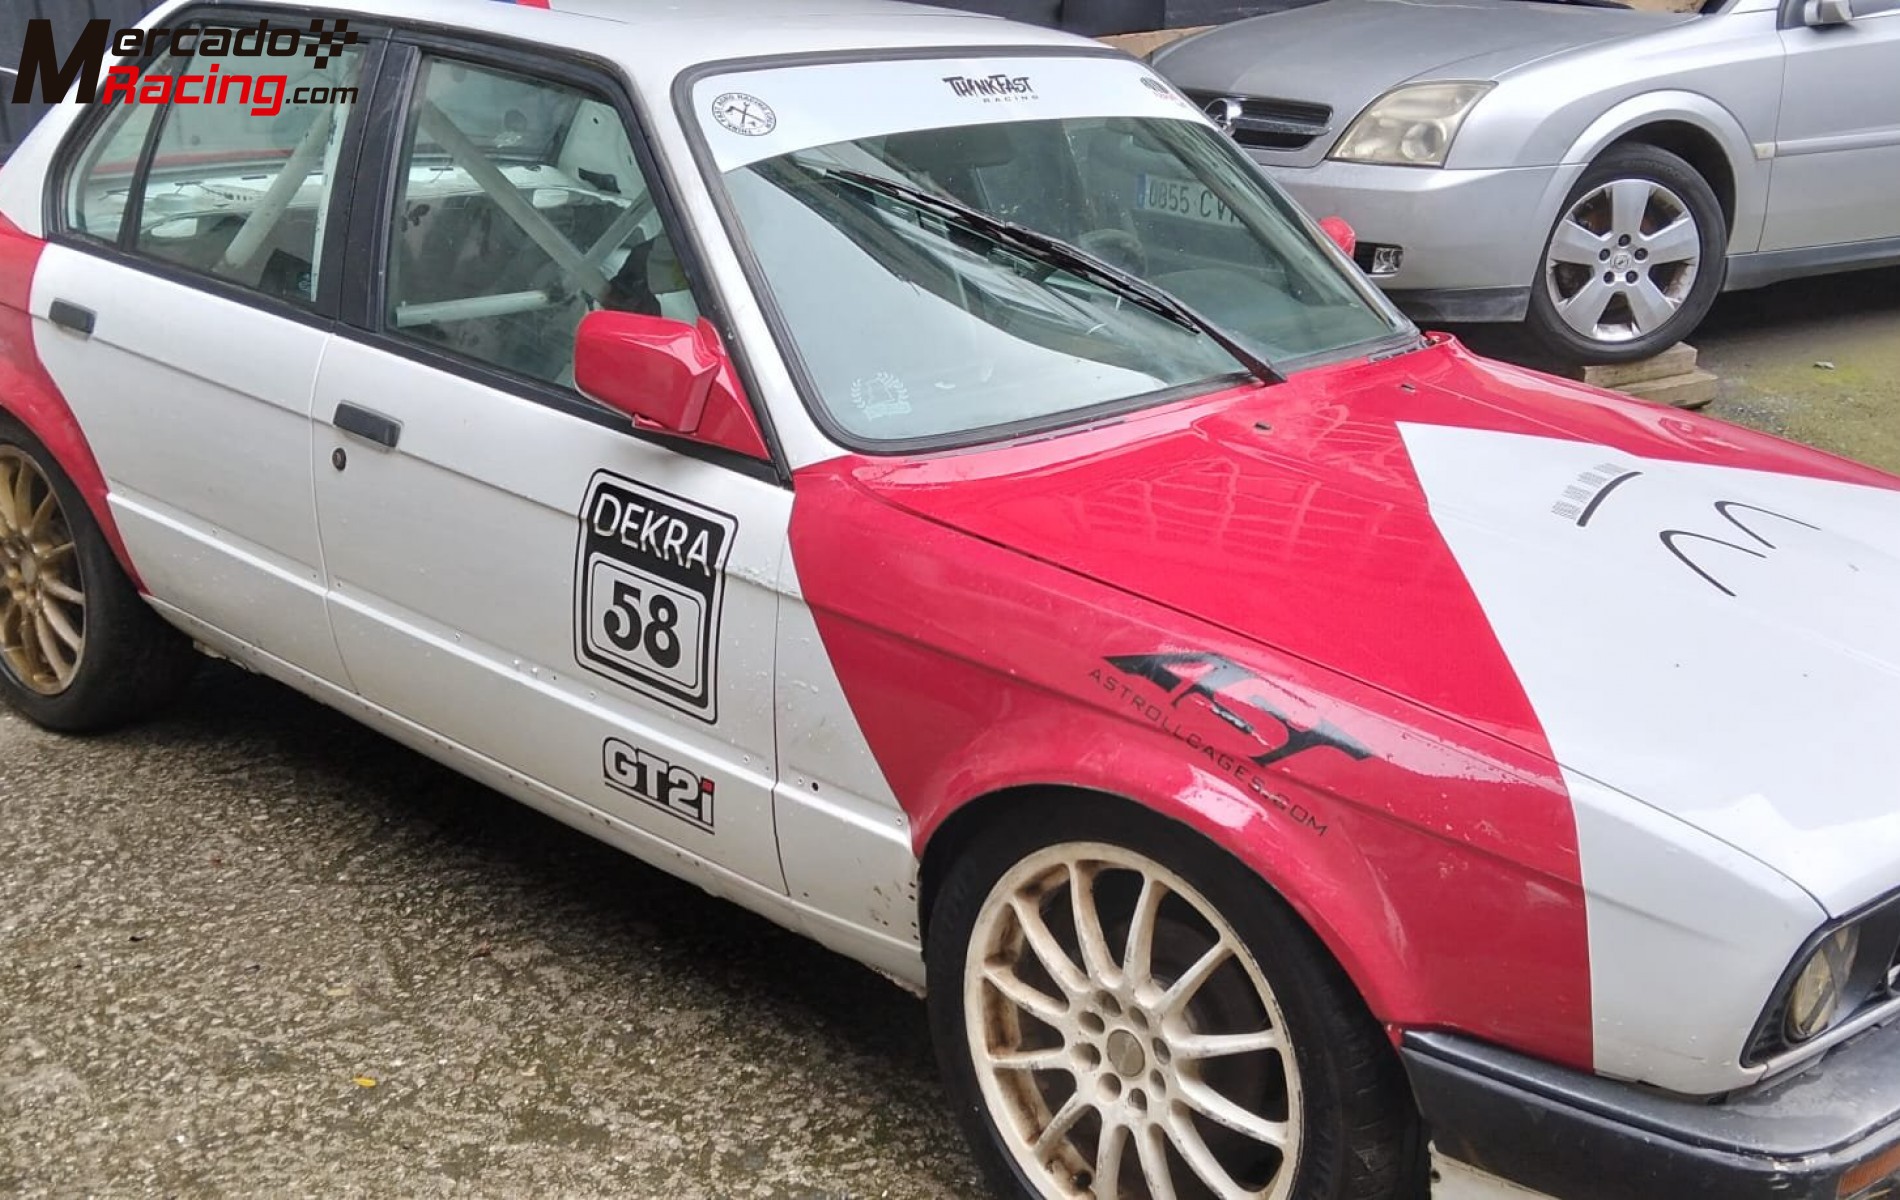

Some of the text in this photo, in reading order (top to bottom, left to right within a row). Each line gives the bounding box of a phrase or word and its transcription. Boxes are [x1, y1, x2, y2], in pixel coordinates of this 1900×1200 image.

[1149, 181, 1239, 223] 0855 CV
[594, 493, 711, 577] DEKRA
[603, 580, 681, 669] 58
